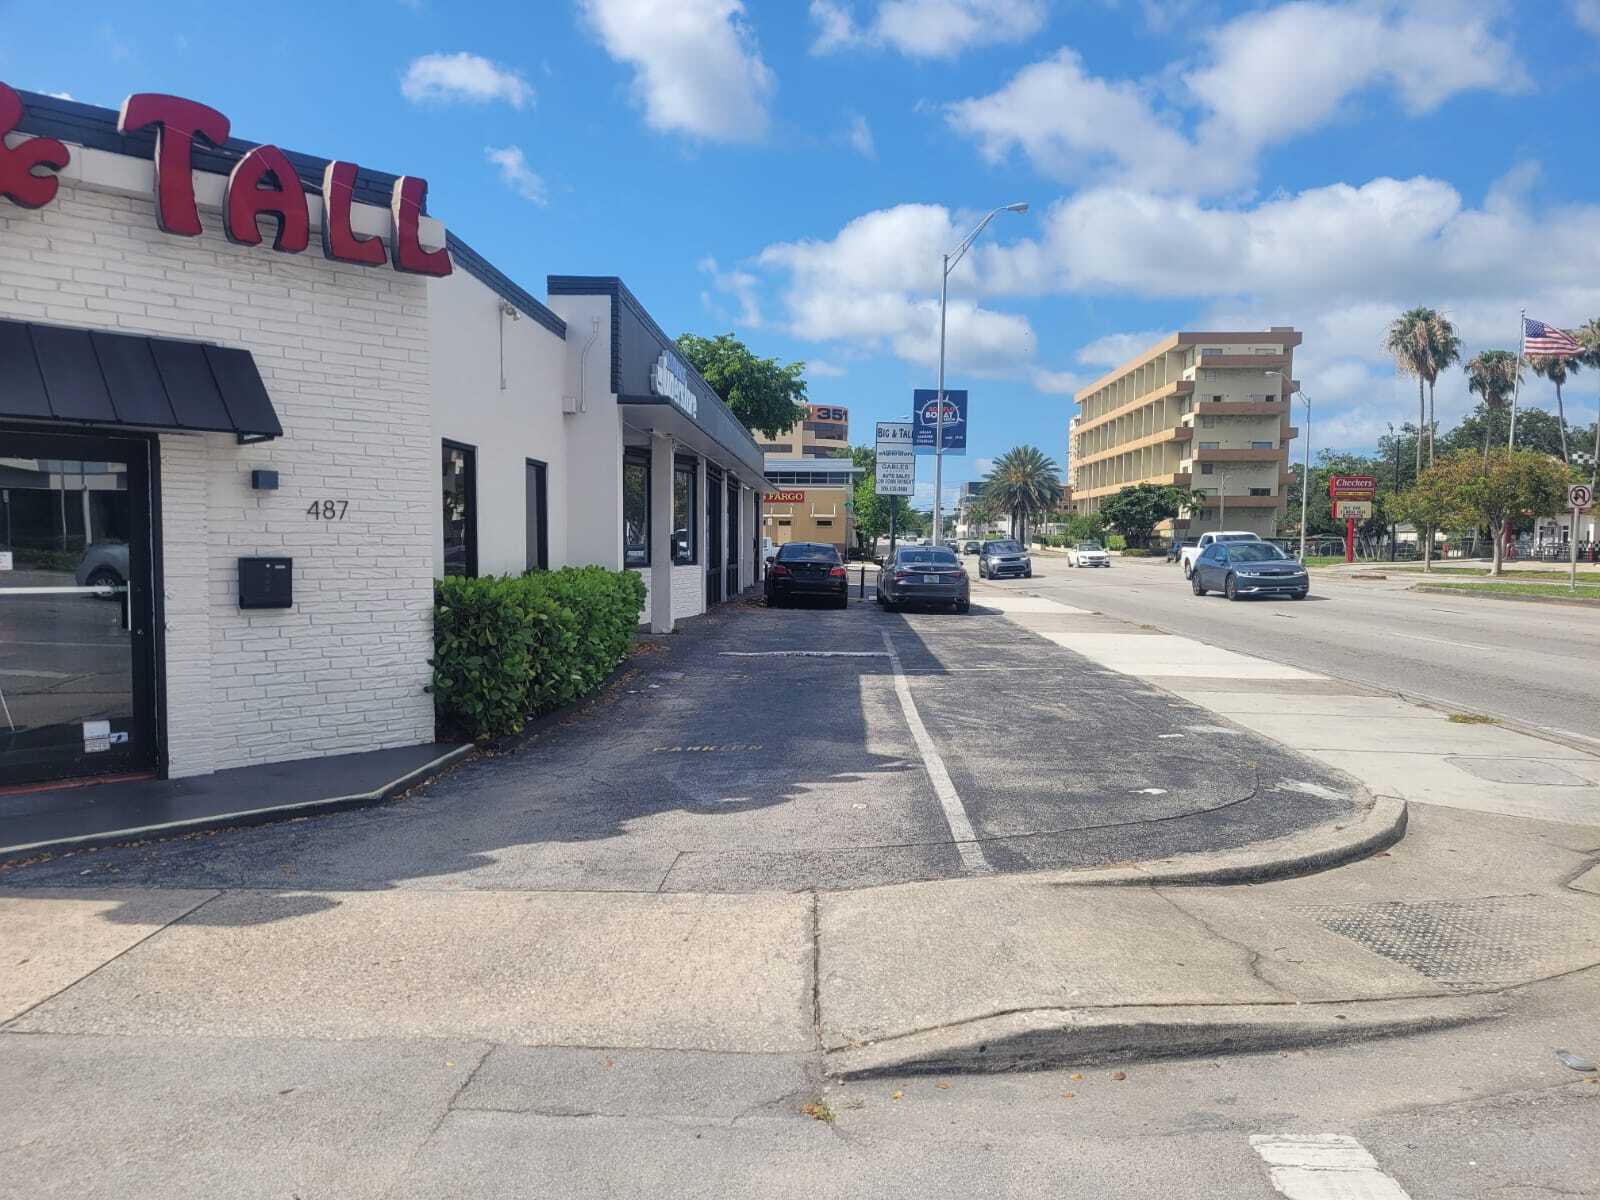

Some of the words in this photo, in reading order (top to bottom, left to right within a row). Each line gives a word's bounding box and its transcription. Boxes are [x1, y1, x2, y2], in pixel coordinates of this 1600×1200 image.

[117, 93, 453, 278] TALL
[877, 427, 890, 438] BIG
[1336, 479, 1372, 487] Checkers
[769, 492, 803, 501] FARGO
[306, 499, 349, 521] 487
